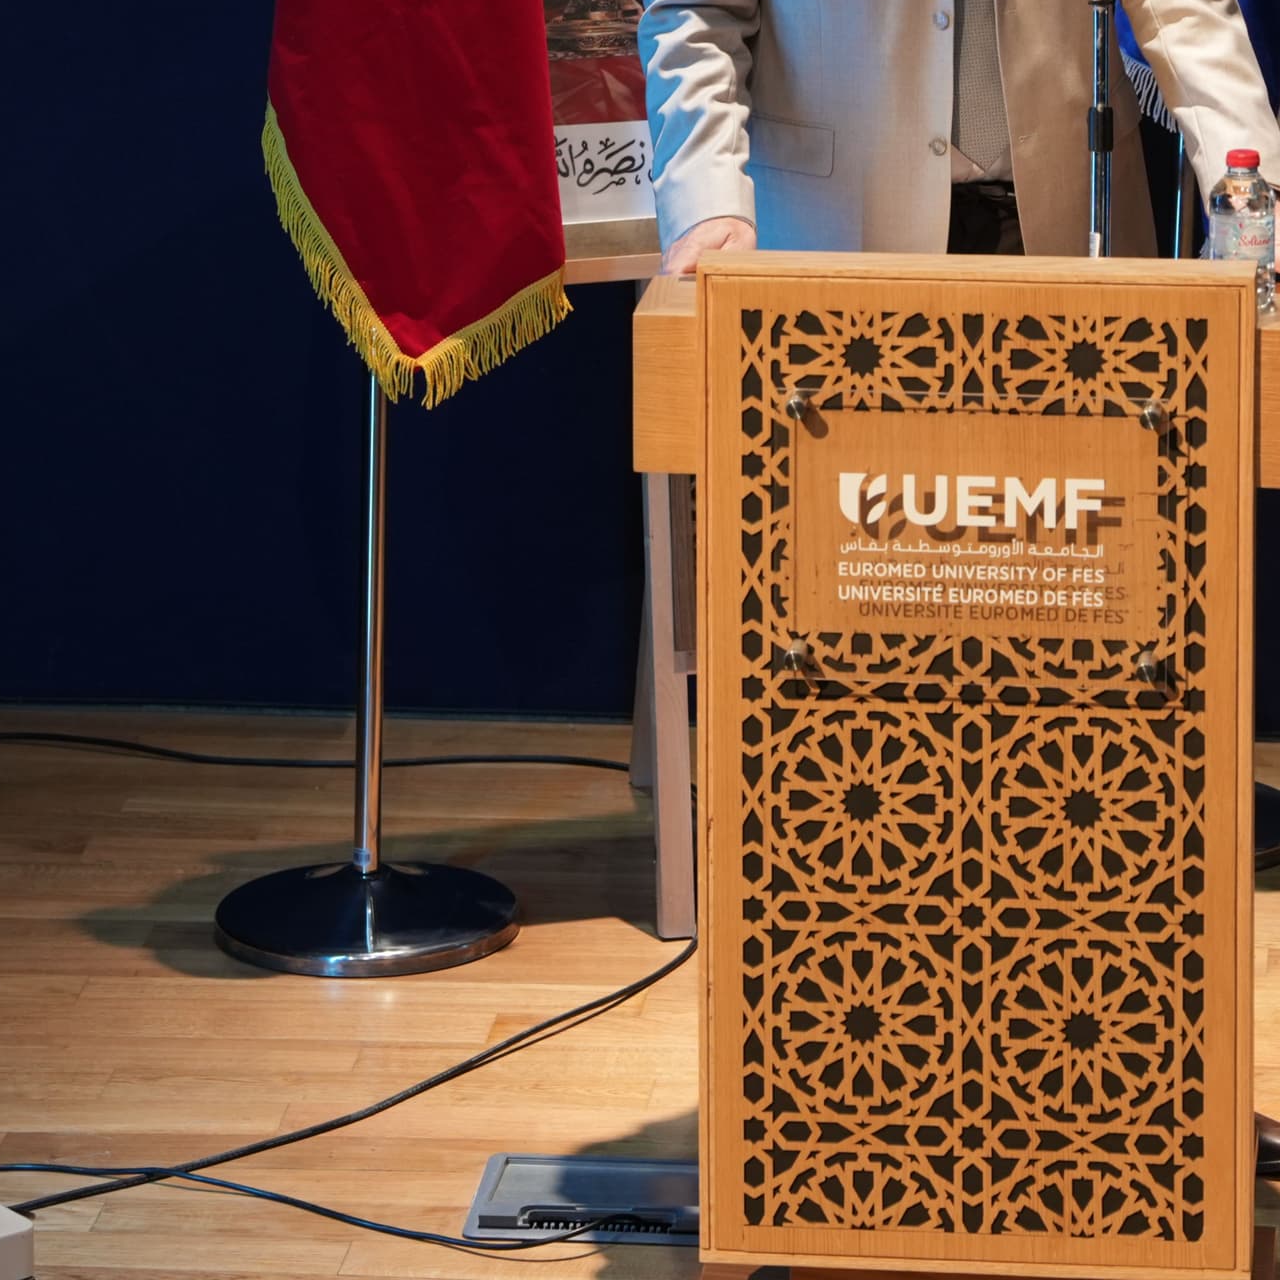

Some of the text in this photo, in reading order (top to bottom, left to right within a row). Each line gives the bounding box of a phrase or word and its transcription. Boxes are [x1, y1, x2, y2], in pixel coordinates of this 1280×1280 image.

[903, 474, 1105, 529] UEMF
[1028, 543, 1104, 560] الجامعة
[838, 561, 1105, 584] EUROMED UNIVERSITY OF FES
[838, 584, 1104, 608] UNIVERSITÉ EUROMED DE FÈS
